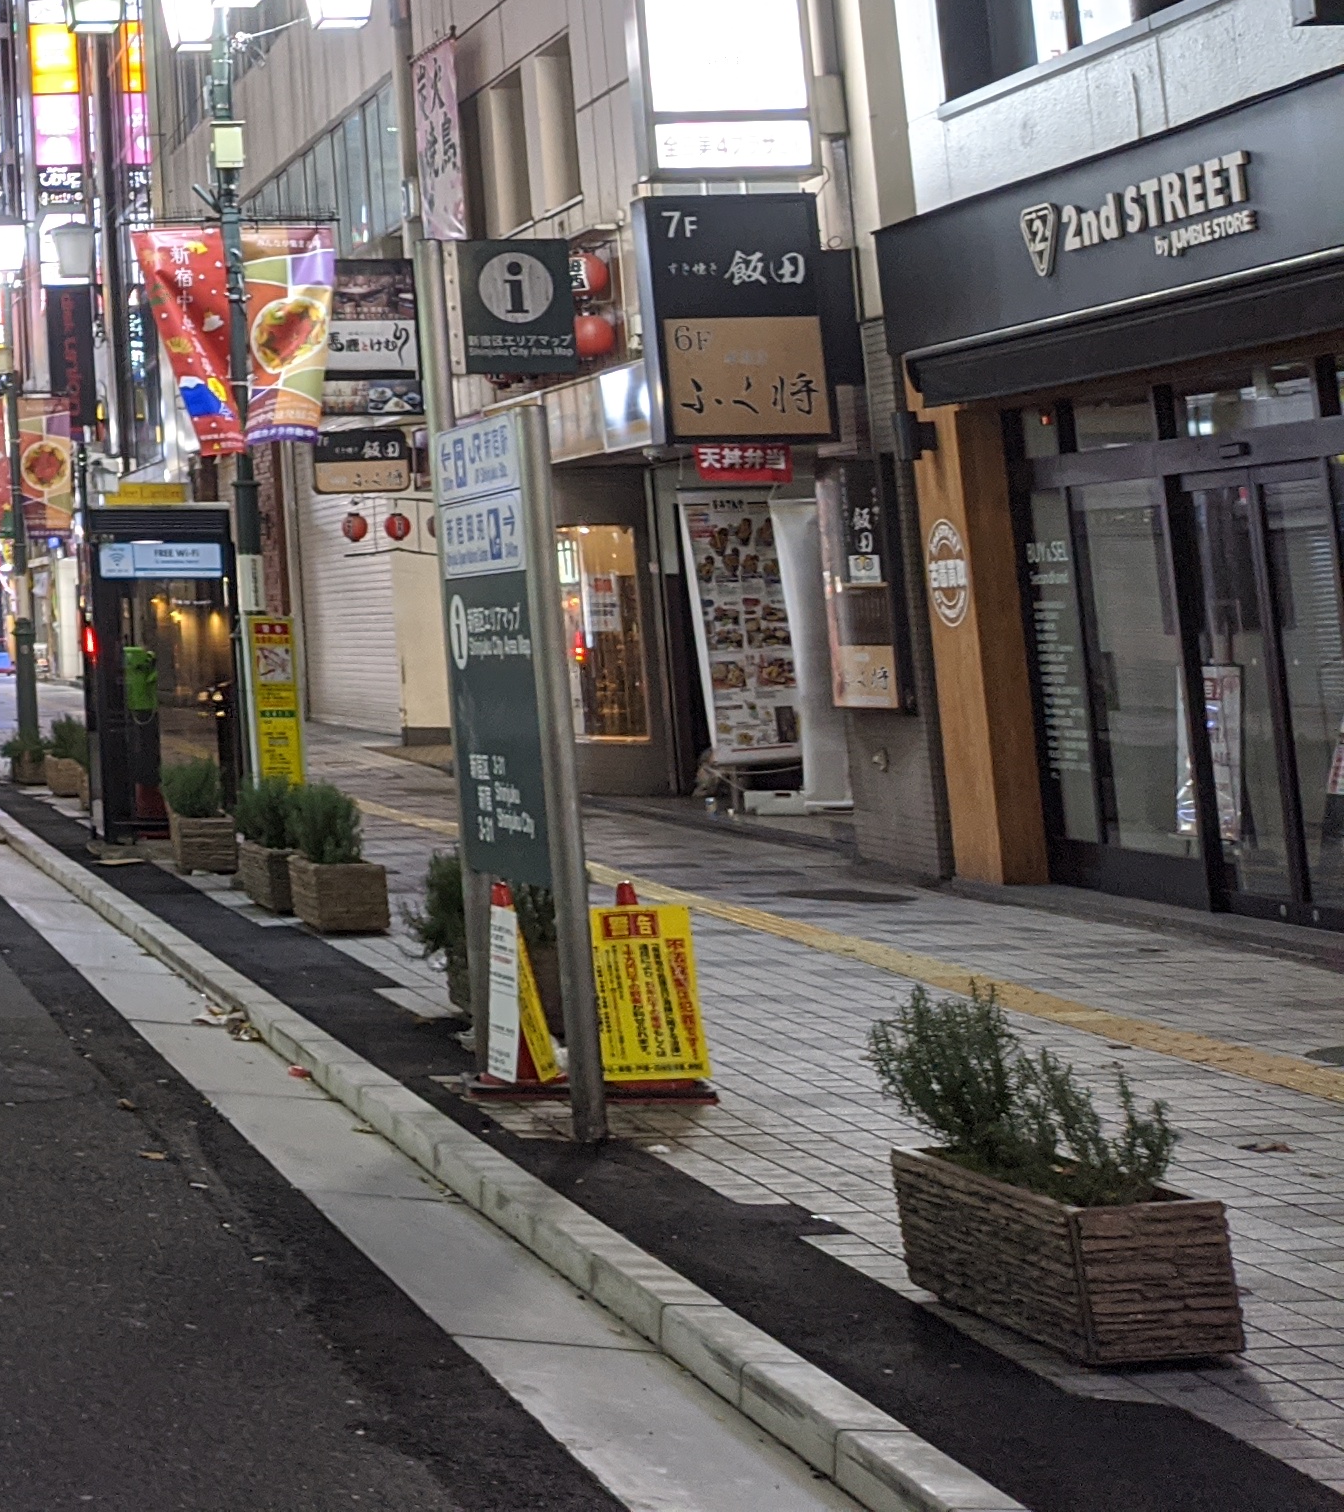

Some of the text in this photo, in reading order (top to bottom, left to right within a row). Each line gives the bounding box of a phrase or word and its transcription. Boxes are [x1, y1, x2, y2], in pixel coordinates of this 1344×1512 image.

[1063, 150, 1250, 252] 2nd STREET
[661, 210, 699, 239] 7F
[1155, 210, 1256, 257] by JUMBLE STORE
[723, 250, 807, 286] 飯田
[468, 334, 572, 348] 新宿区エリアマップ
[673, 325, 711, 352] 6F
[468, 347, 574, 358] Shinjuku City Area Map
[362, 440, 401, 459] 飯田
[698, 448, 788, 471] 天丼弁当
[153, 548, 174, 558] FREE
